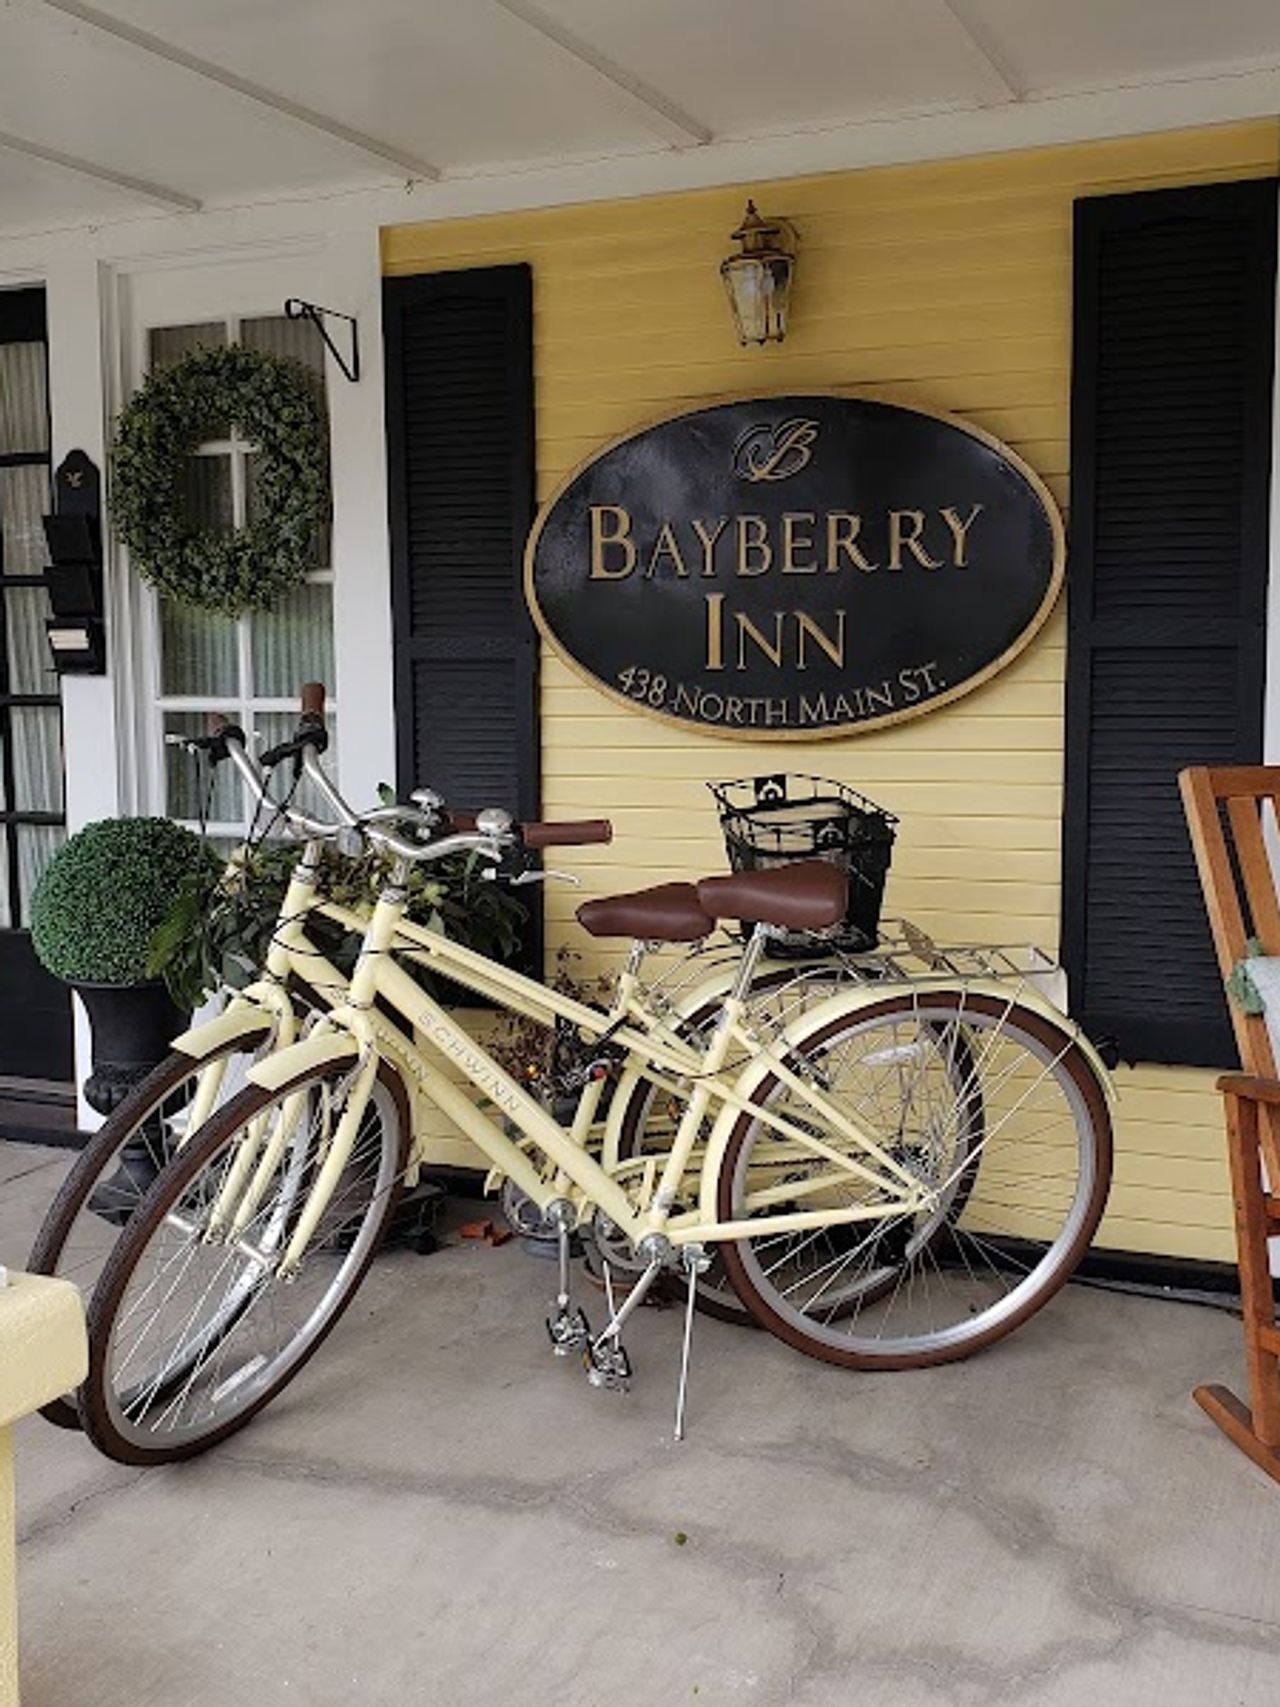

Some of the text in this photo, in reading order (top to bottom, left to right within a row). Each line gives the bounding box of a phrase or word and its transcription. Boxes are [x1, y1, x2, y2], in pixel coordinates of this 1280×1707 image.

[589, 505, 983, 580] BAYBERRY
[704, 593, 846, 670] INN
[618, 662, 946, 725] 438 NORTH MAIN ST.
[418, 1010, 520, 1111] SCHWINN
